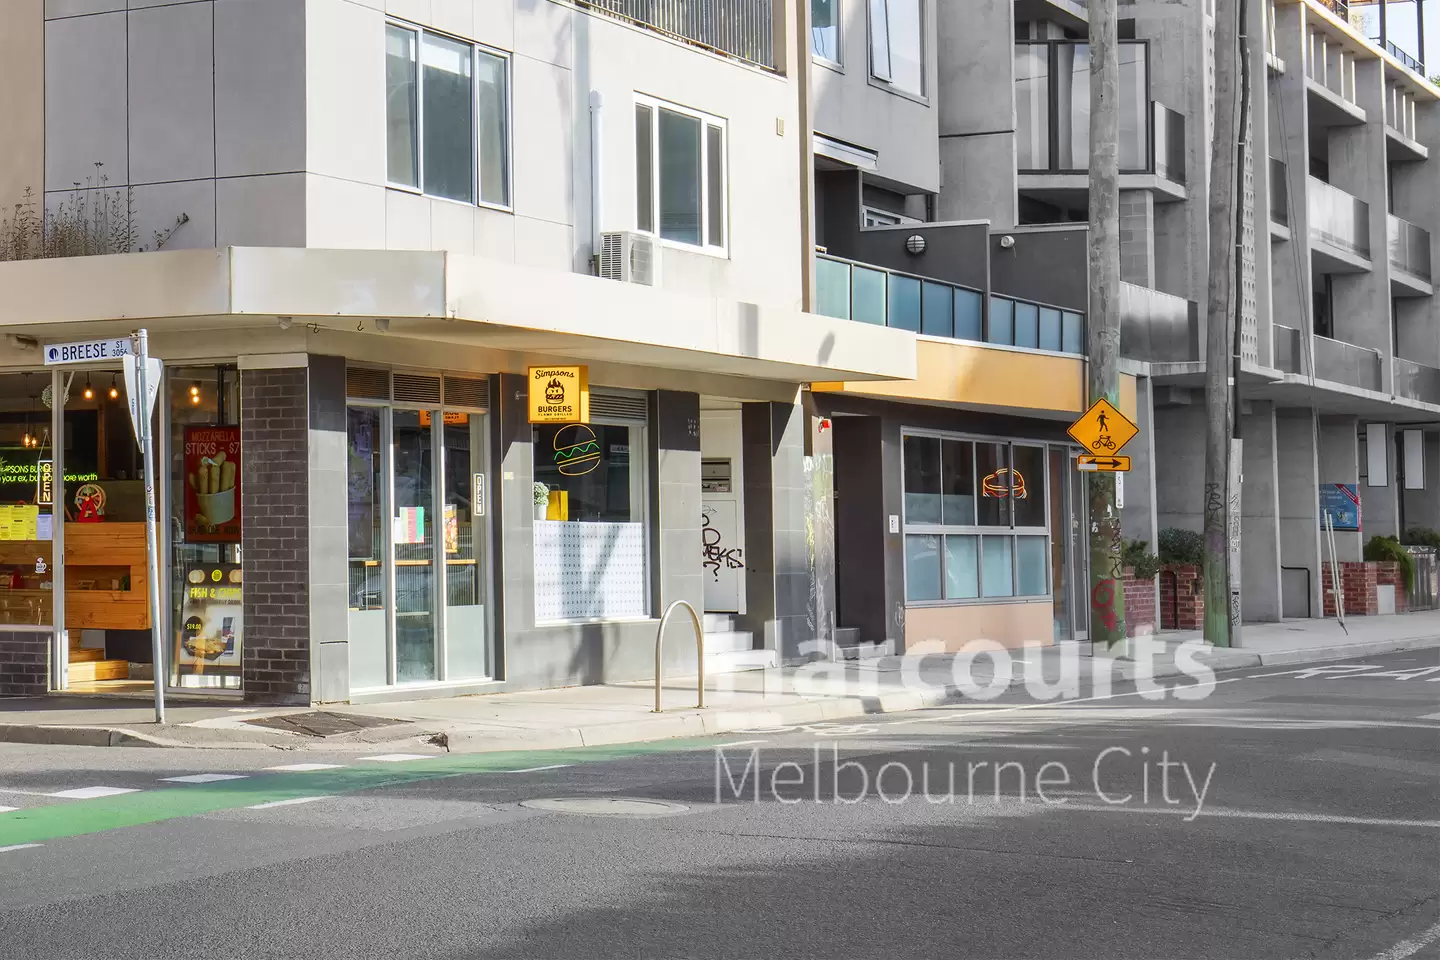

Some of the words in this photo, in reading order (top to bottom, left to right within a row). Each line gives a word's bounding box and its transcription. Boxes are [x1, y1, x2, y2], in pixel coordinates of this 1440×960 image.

[62, 343, 107, 360] BREESE
[112, 348, 128, 357] 3056
[535, 369, 575, 380] Simpsons
[538, 405, 573, 413] BURGERS
[191, 432, 235, 441] MOZZARELLA
[185, 442, 217, 455] STICKS
[78, 473, 98, 481] worth
[42, 463, 51, 502] OPEN
[190, 588, 208, 598] FISH
[210, 588, 216, 598] &
